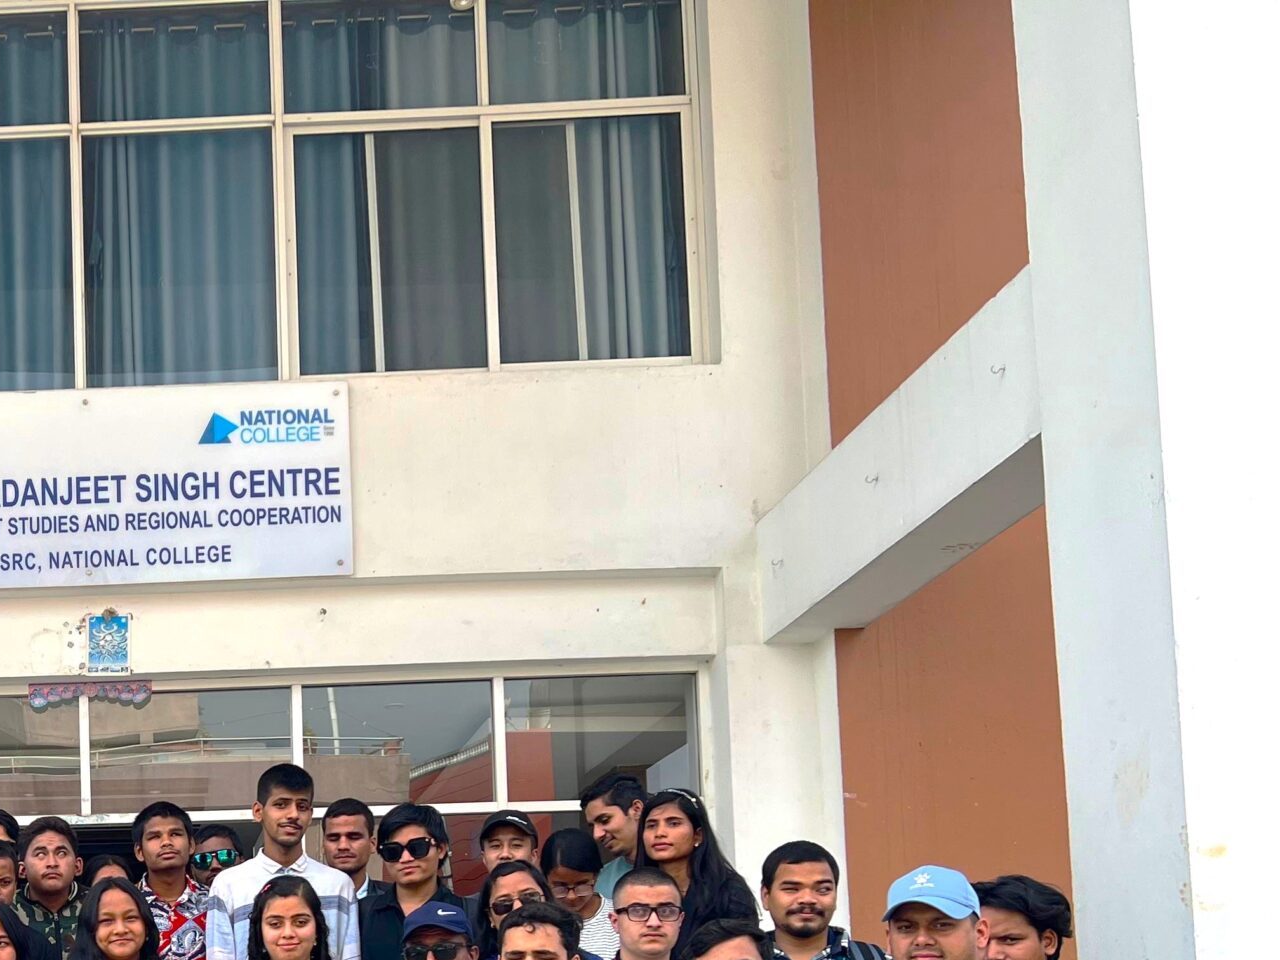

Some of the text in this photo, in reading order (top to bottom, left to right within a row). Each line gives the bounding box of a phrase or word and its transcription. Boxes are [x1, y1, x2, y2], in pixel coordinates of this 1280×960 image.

[240, 408, 335, 426] NATIONAL
[240, 426, 321, 444] COLLEGE
[135, 471, 220, 503] SINGH
[229, 466, 341, 499] CENTRE
[7, 514, 80, 536] STUDIES
[83, 513, 120, 533] AND
[125, 510, 214, 531] REGIONAL
[217, 504, 342, 528] COOPERATION
[49, 548, 140, 570] NATIONAL
[146, 544, 232, 566] COLLEGE
